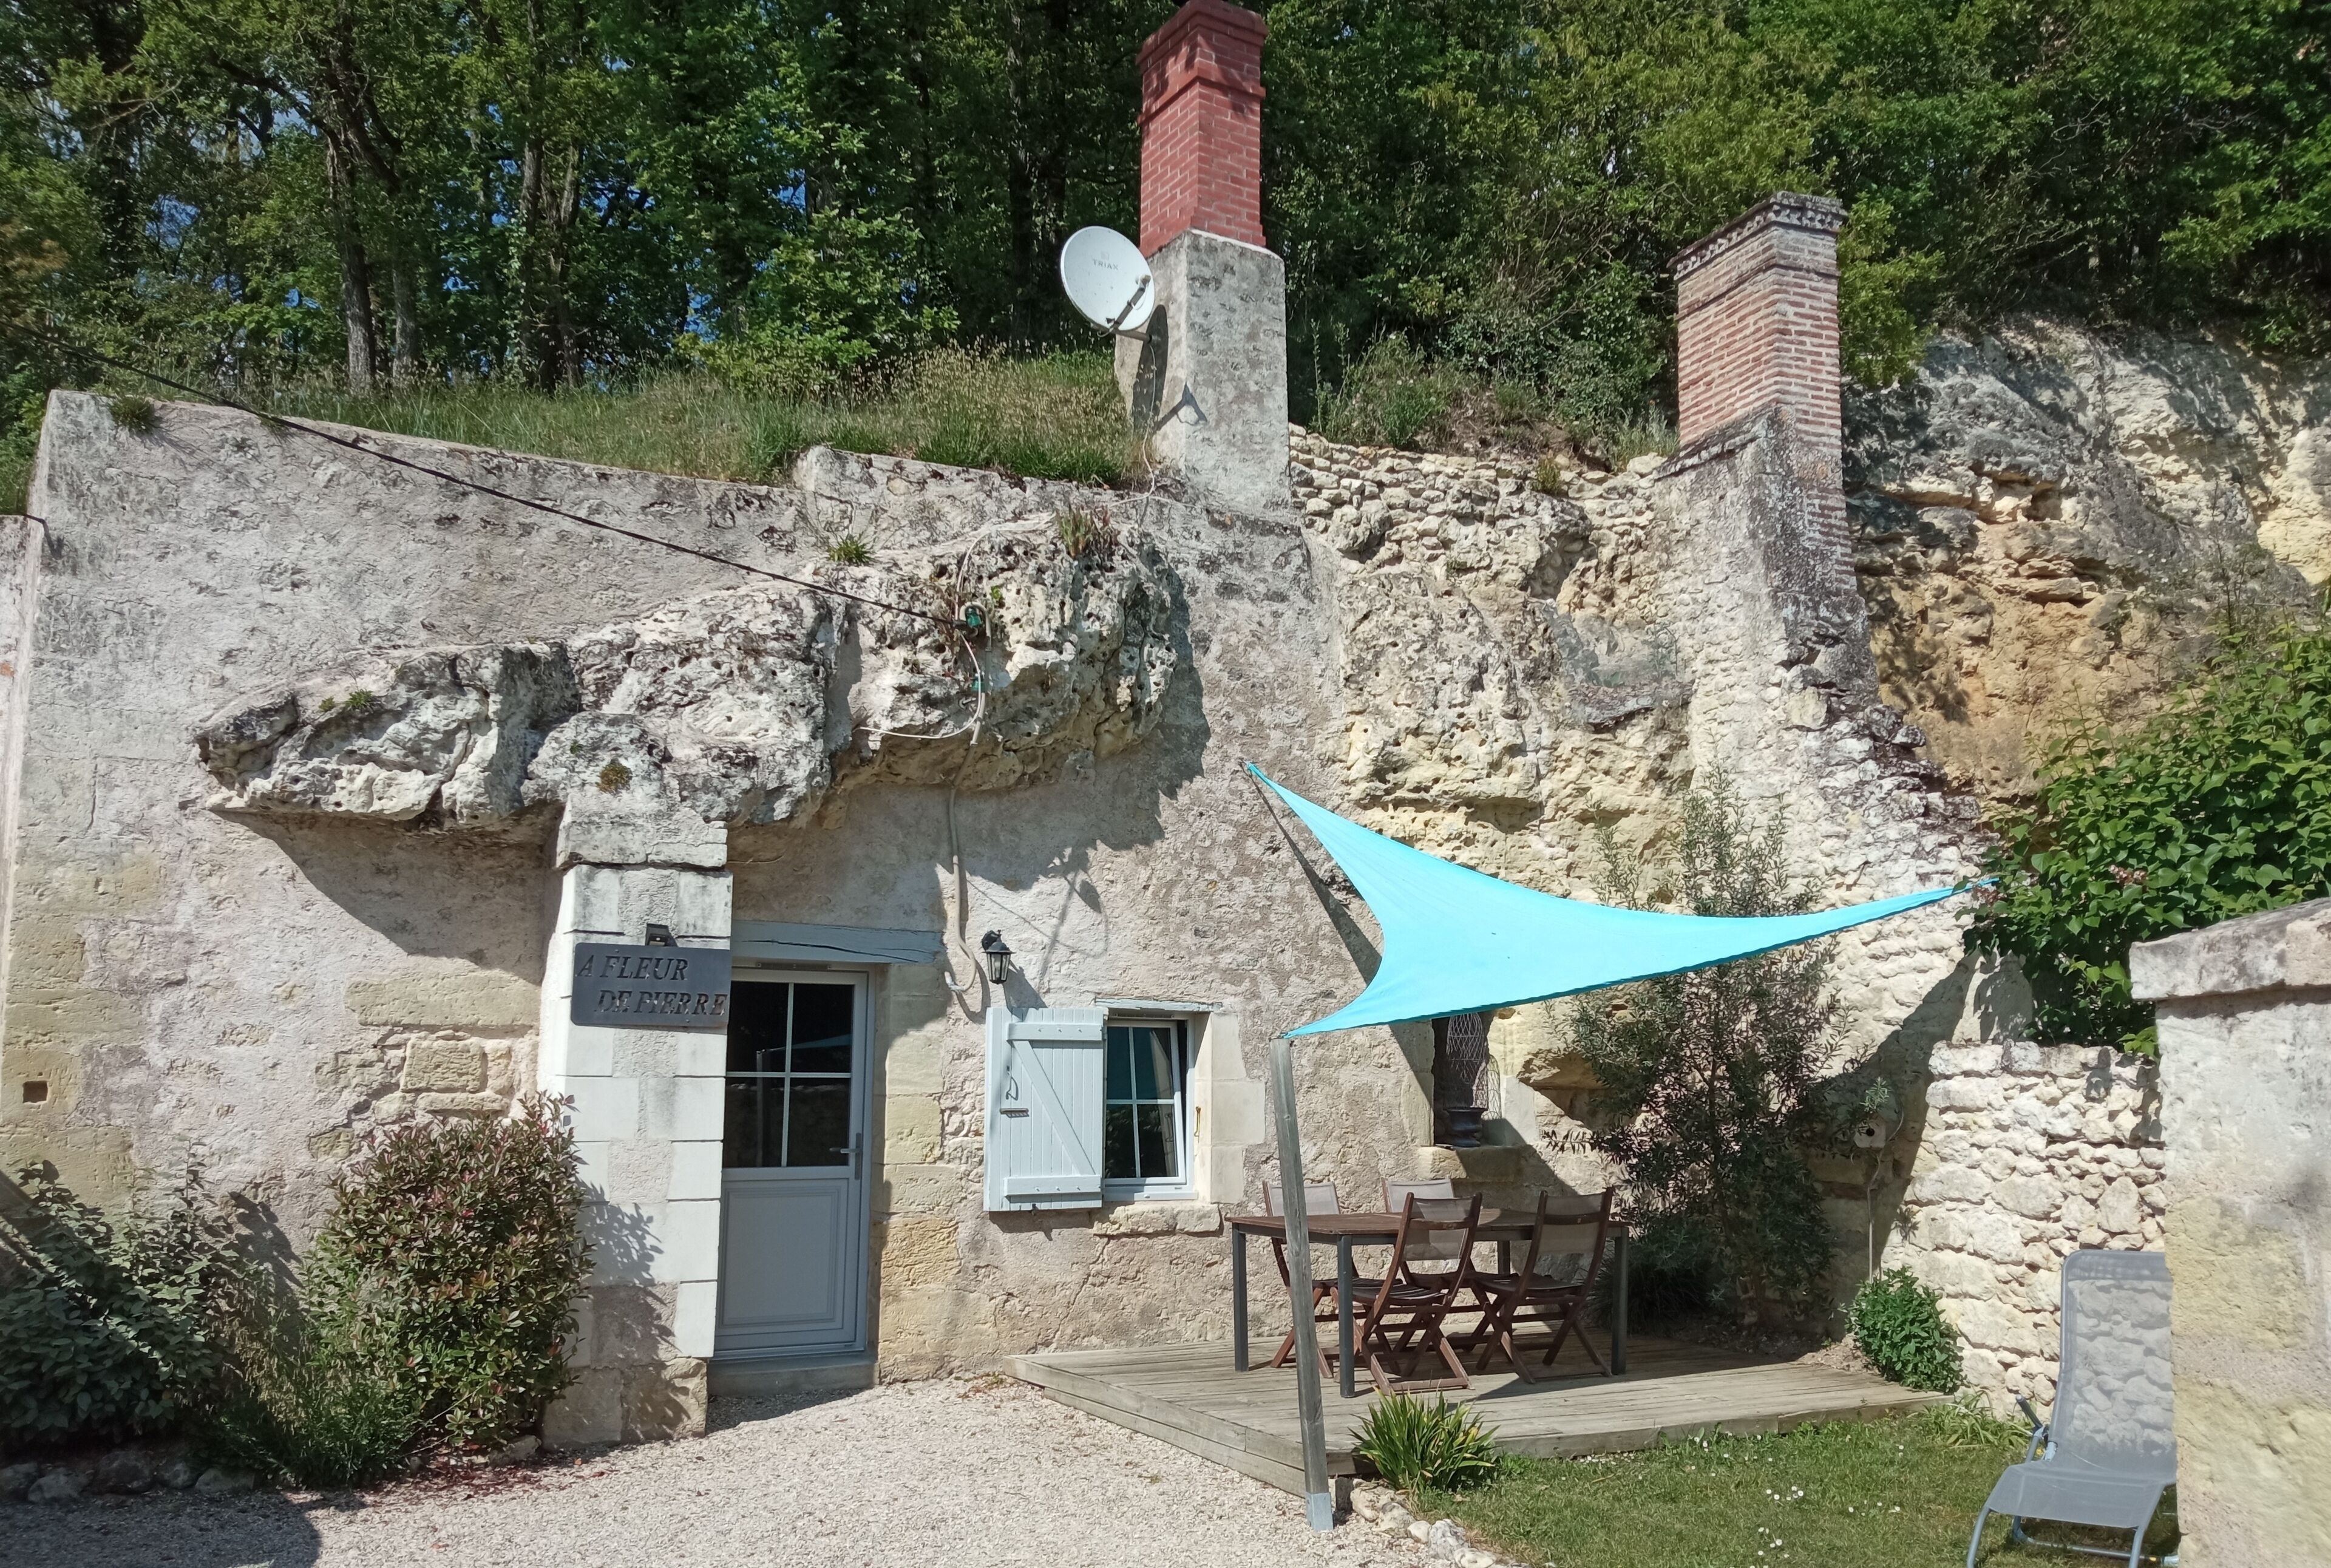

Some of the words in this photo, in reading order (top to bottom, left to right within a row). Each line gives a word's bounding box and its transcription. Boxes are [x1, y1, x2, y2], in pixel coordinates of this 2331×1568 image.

[1092, 259, 1118, 270] TRIAX
[577, 954, 595, 977] A
[599, 955, 688, 980] FLEUR
[594, 989, 633, 1012] DE
[634, 991, 728, 1016] PIERRE
